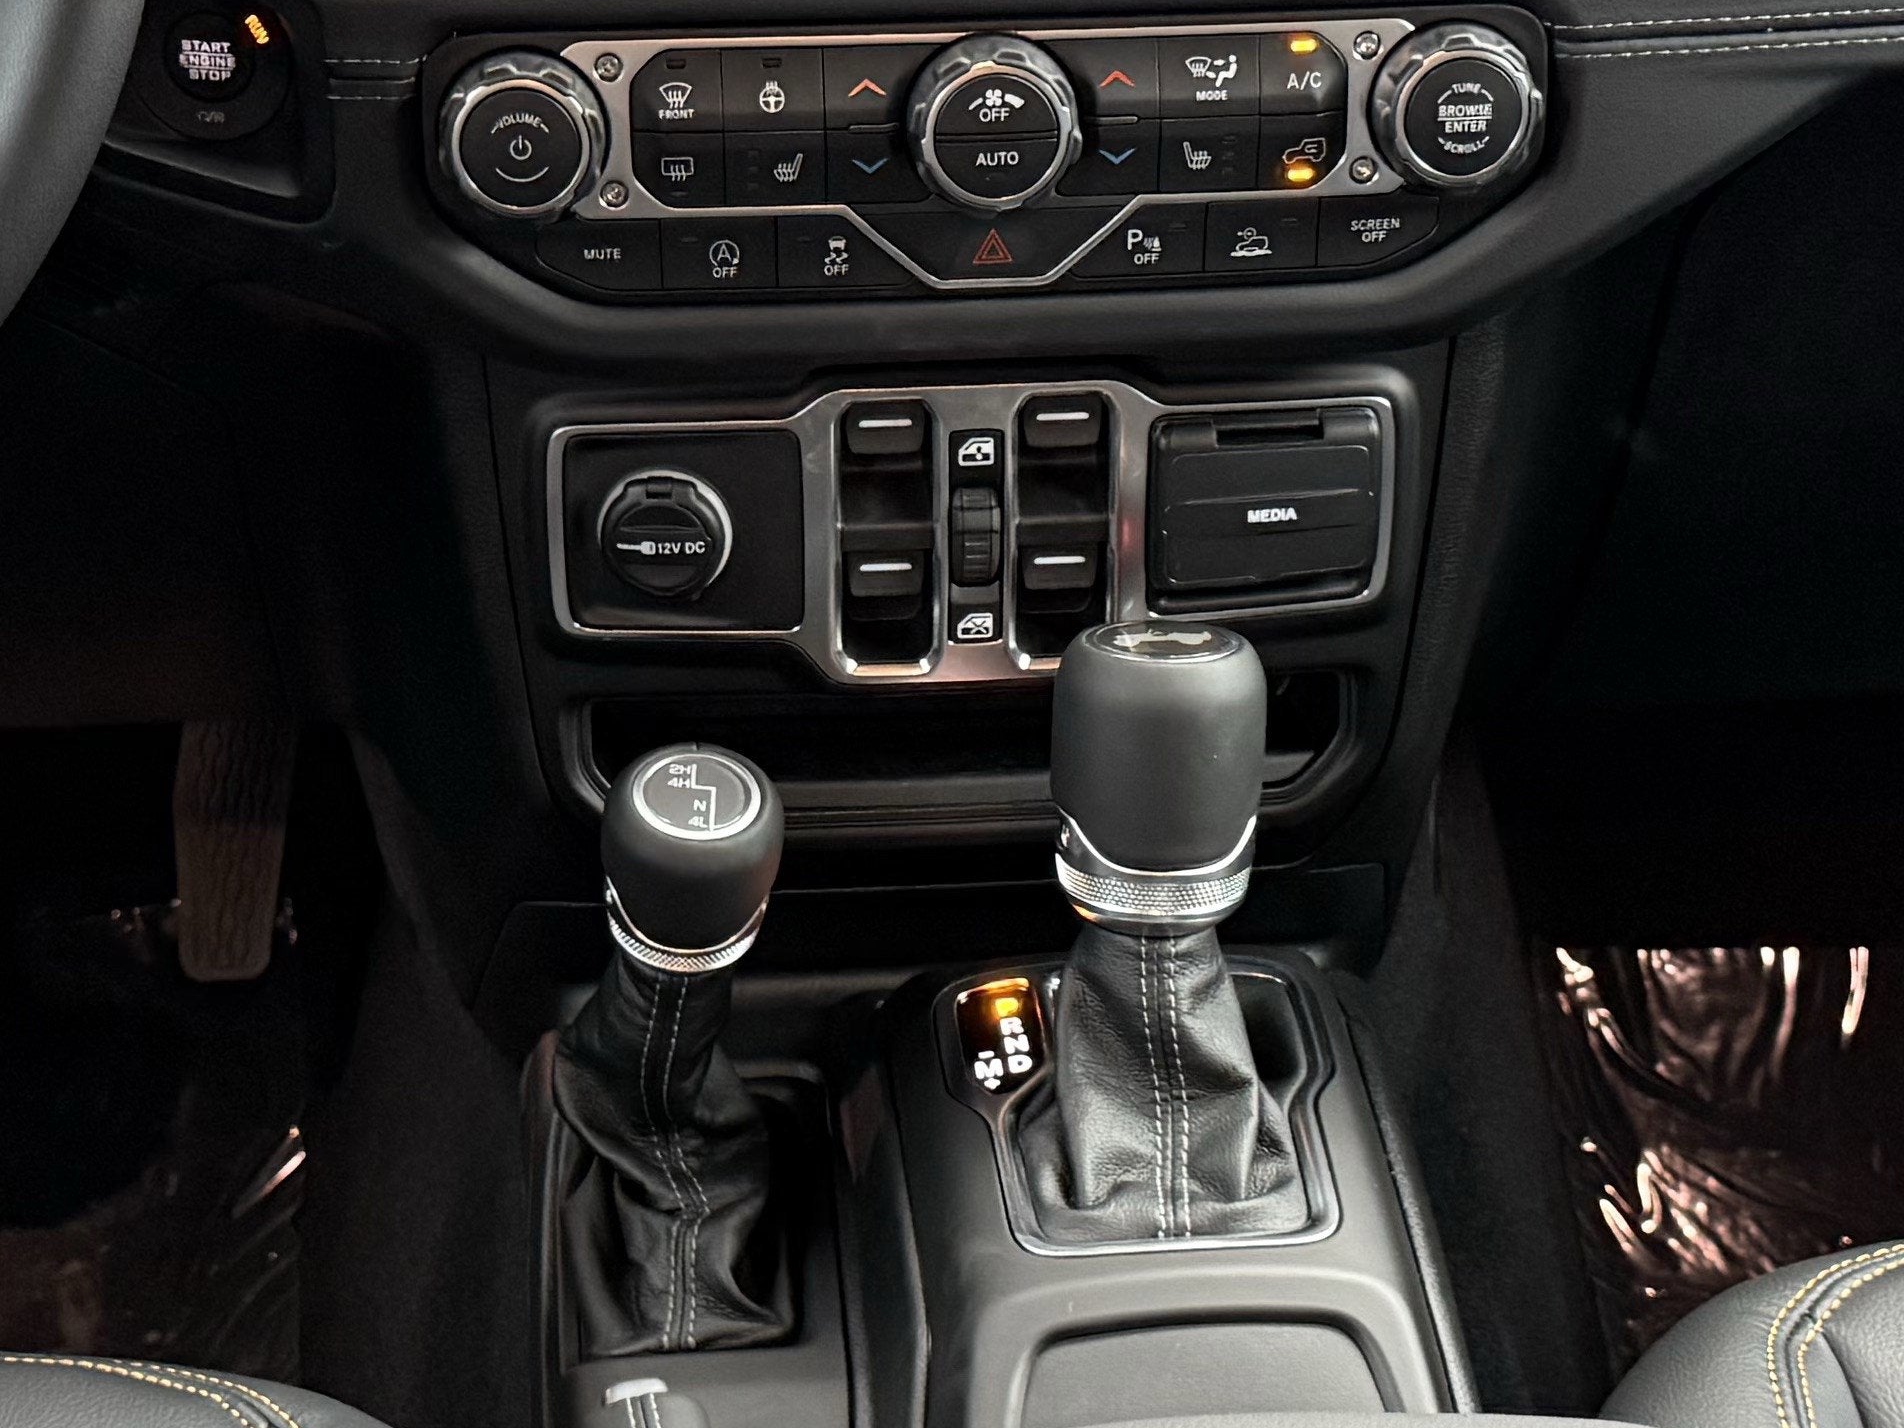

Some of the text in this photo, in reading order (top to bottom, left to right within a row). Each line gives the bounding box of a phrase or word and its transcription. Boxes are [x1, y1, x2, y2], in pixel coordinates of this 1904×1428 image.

[181, 39, 231, 53] START
[179, 54, 236, 71] ENGINE
[189, 69, 231, 82] STOP
[1287, 72, 1322, 90] A/C
[1196, 90, 1228, 102] MODE
[1451, 83, 1482, 95] TUNE
[658, 109, 695, 120] FRONT
[979, 108, 1010, 123] OFF
[1438, 103, 1493, 117] BROWSE
[496, 112, 542, 129] VOLUME
[1444, 120, 1487, 134] ENTER
[1442, 138, 1486, 155] SCROLL
[975, 152, 1019, 167] AUTO
[1350, 218, 1400, 232] SCREEN
[1361, 230, 1387, 243] OFF
[583, 248, 621, 260] MUTE
[1133, 253, 1160, 265] OFF
[713, 267, 737, 279] OFF
[824, 264, 849, 276] OFF
[1247, 507, 1297, 523] MEDIA
[657, 541, 705, 554] 12V DC
[667, 777, 690, 788] 4H
[693, 799, 706, 811] N
[688, 816, 708, 828] 4L
[999, 1016, 1024, 1035] R
[1004, 1034, 1030, 1054] N
[974, 1058, 1004, 1079] M
[1007, 1054, 1033, 1073] D
